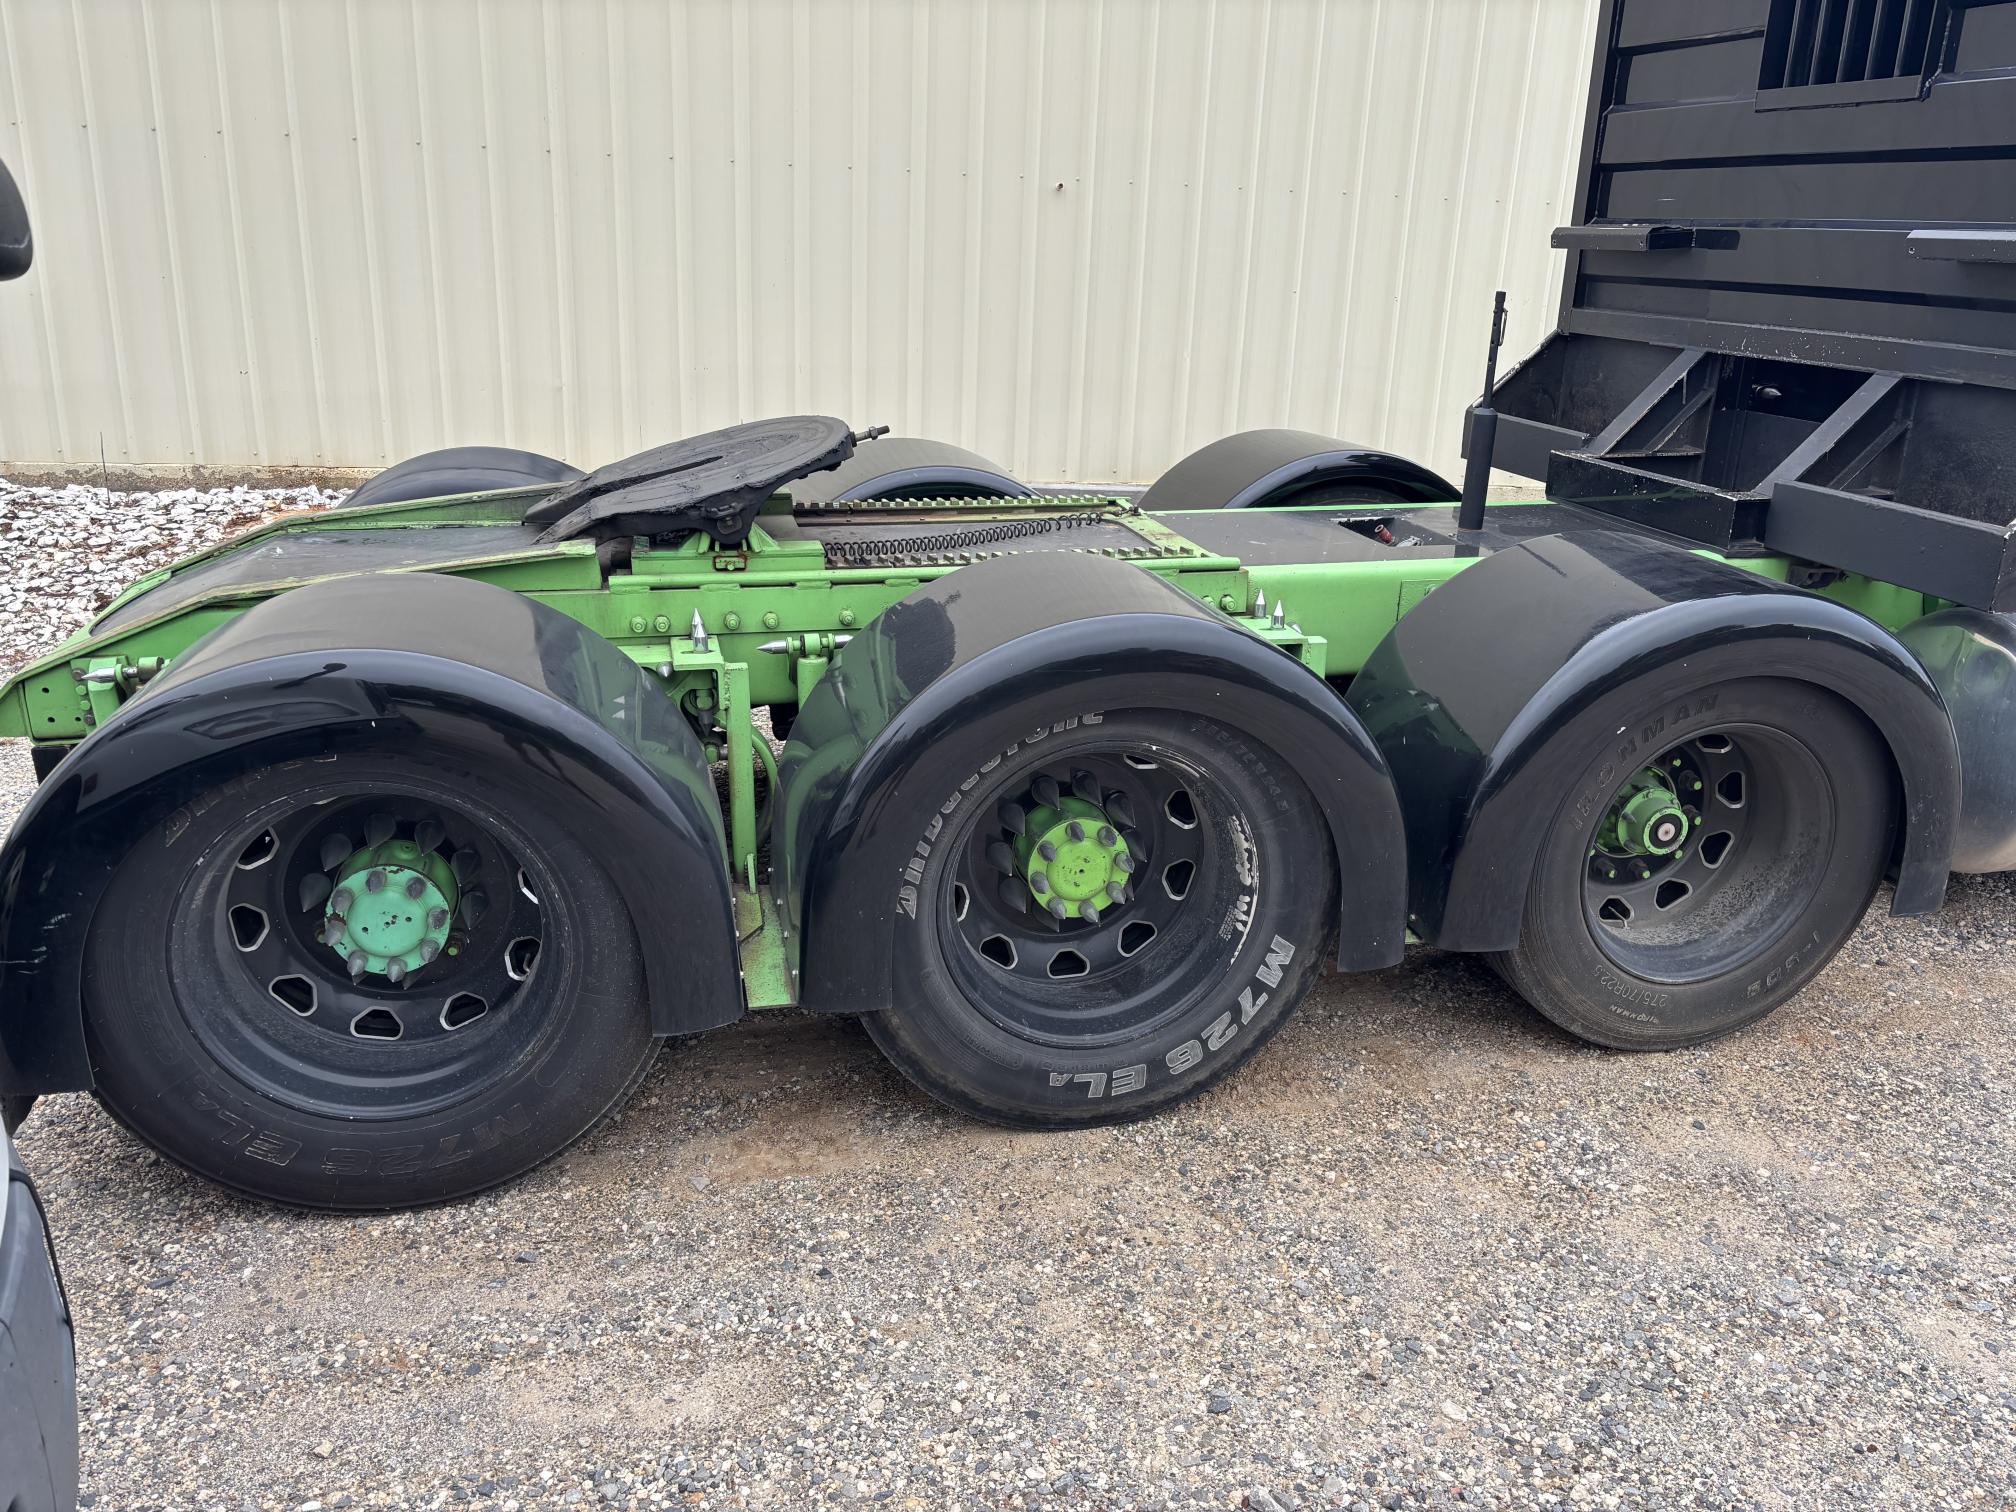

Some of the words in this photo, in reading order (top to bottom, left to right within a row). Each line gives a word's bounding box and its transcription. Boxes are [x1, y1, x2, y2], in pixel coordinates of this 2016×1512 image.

[1568, 693, 1720, 832] IRONMAN
[1166, 934, 1296, 1075] M726
[1592, 964, 1669, 1008] 275/70R22.5
[1608, 1004, 1658, 1023] IRONMAN
[319, 1102, 531, 1176] M726
